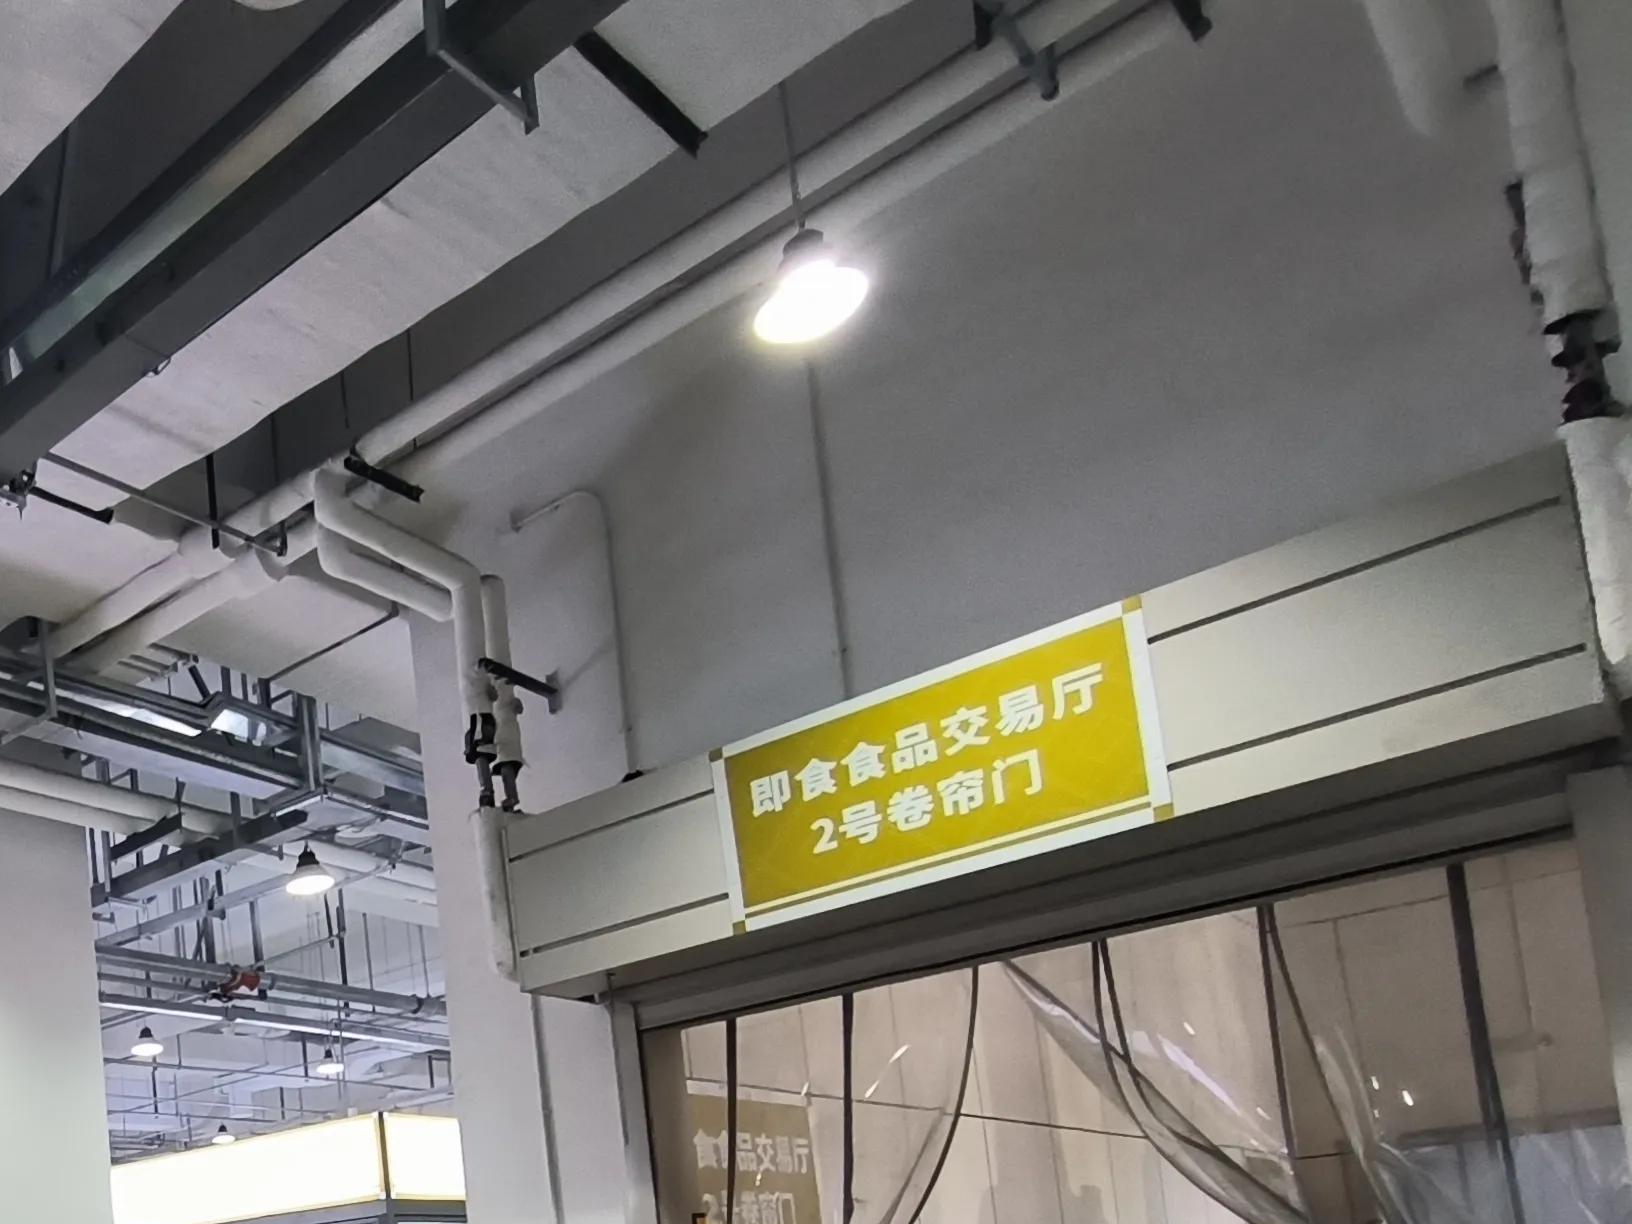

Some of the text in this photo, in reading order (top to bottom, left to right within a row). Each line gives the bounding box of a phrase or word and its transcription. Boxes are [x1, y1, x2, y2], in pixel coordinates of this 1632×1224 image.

[749, 662, 1103, 818] 即食食品交易厅
[810, 749, 1043, 855] 2号卷帘门
